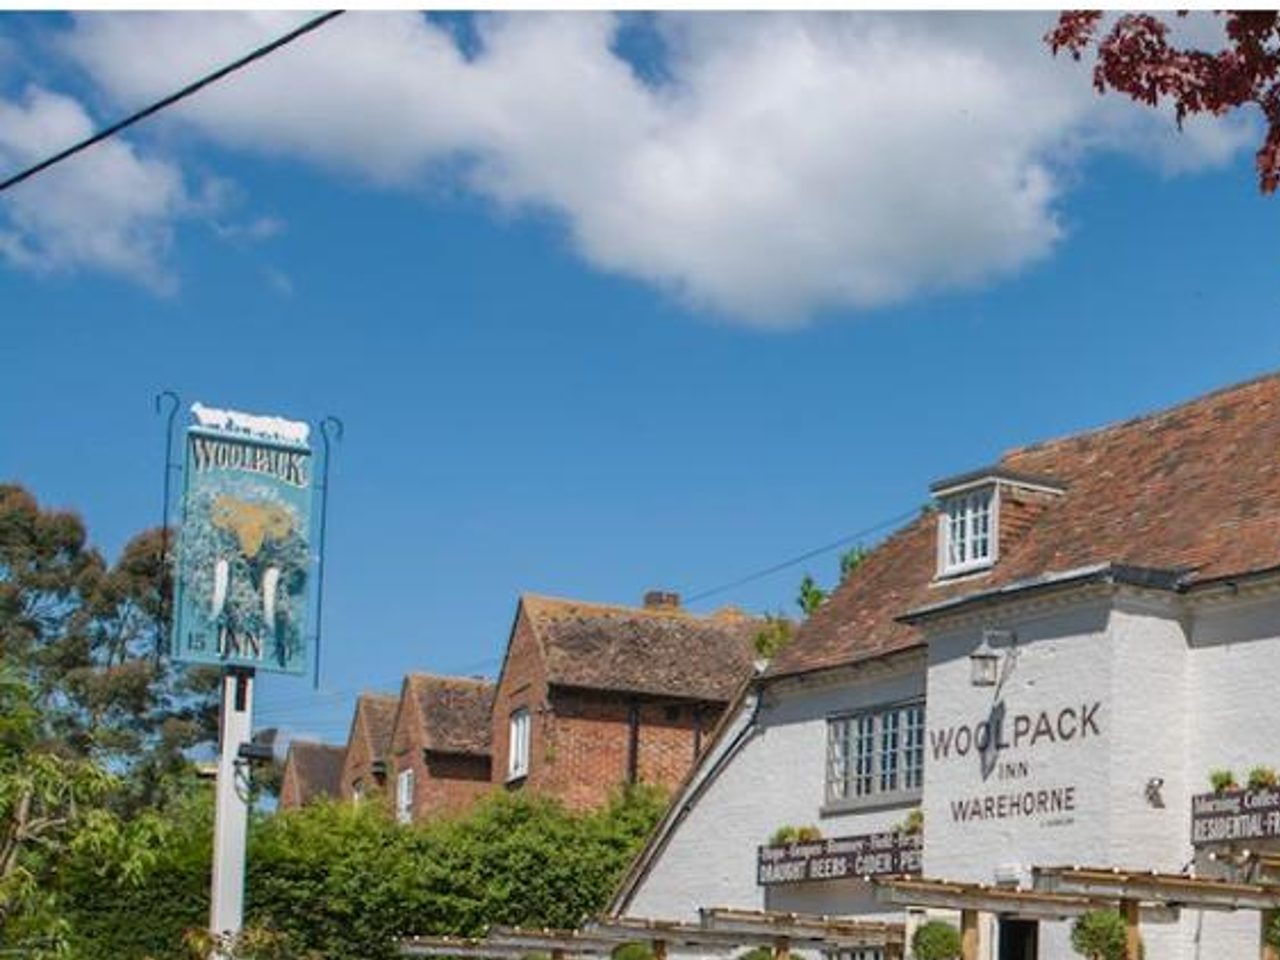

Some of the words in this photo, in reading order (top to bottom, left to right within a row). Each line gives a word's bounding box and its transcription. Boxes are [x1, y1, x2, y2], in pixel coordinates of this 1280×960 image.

[192, 438, 307, 488] WOOLPACK
[217, 625, 263, 660] INN
[930, 702, 1101, 760] WOOLPACK
[998, 762, 1029, 779] INN
[950, 787, 1076, 822] WAREHORNE
